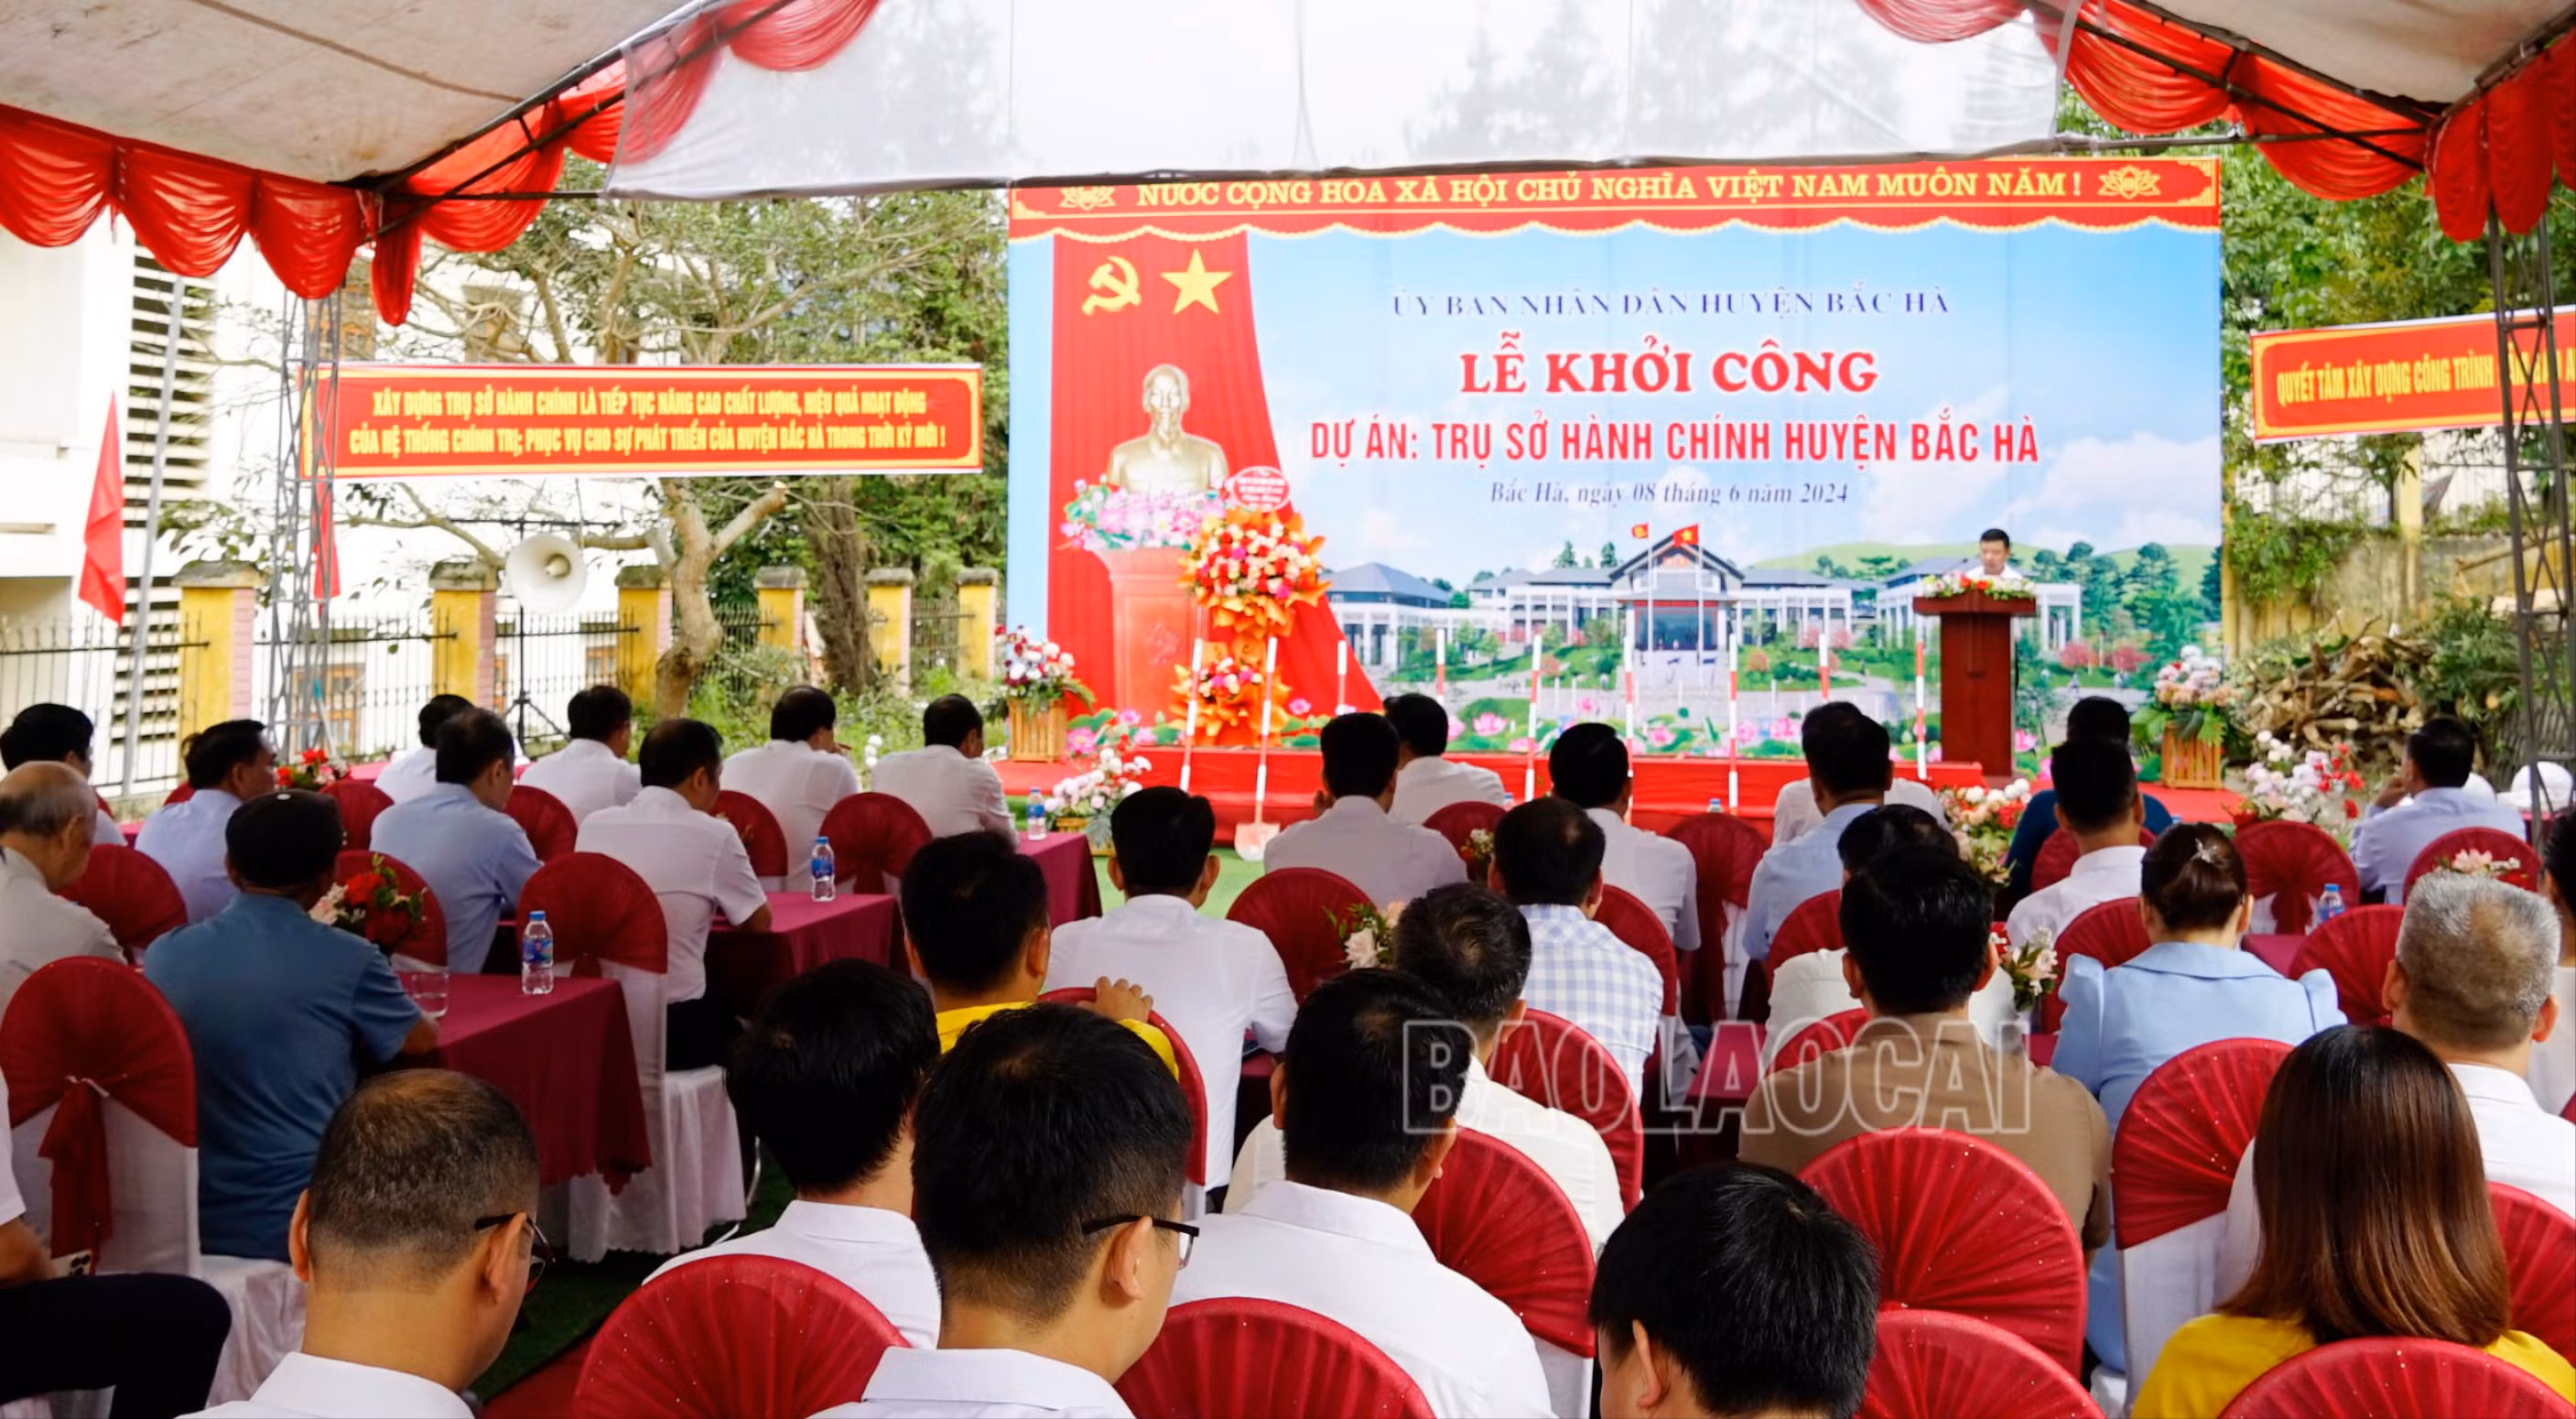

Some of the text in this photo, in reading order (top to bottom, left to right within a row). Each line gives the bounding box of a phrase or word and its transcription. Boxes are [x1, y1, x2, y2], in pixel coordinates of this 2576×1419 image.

[1394, 176, 1442, 203] XÃ
[1449, 173, 1508, 208] HỘI
[1516, 170, 1583, 201] CHỦ
[1590, 171, 1697, 200] NGHĨA
[1706, 168, 1784, 204] VIỆT
[1791, 174, 1869, 198] NAM
[1877, 166, 1977, 197] MUÔN
[1986, 168, 2066, 196] NĂM
[2073, 173, 2081, 196] !
[1446, 295, 1510, 315] BAN
[1521, 287, 1609, 315] NHÂN
[1623, 287, 1687, 314] DÂN
[1702, 286, 1813, 320] HUYỆN
[1827, 280, 1892, 313] BẮC
[1905, 286, 1949, 313] HÀ
[1459, 331, 1878, 393] LỄ KHỞI CÔNG
[2277, 361, 2314, 406] QUYẾT
[2316, 362, 2345, 400] TÂM
[2346, 359, 2372, 398] XÂY
[2375, 360, 2411, 403] DỰNG
[2413, 353, 2451, 393] CÔNG
[2452, 349, 2495, 390] TRÌNH
[1311, 407, 2039, 471] DỰ ÁN: TRỤ SỞ HÀNH CHÍNH HUYỆN BẮC HÀ
[1490, 478, 1527, 503] Bắc
[1577, 482, 1626, 508] ngày
[1632, 482, 1656, 503] 08
[1663, 482, 1722, 505] tháng
[1729, 483, 1740, 503] 6
[1748, 482, 1792, 503] năm
[1800, 482, 1848, 504] 2024
